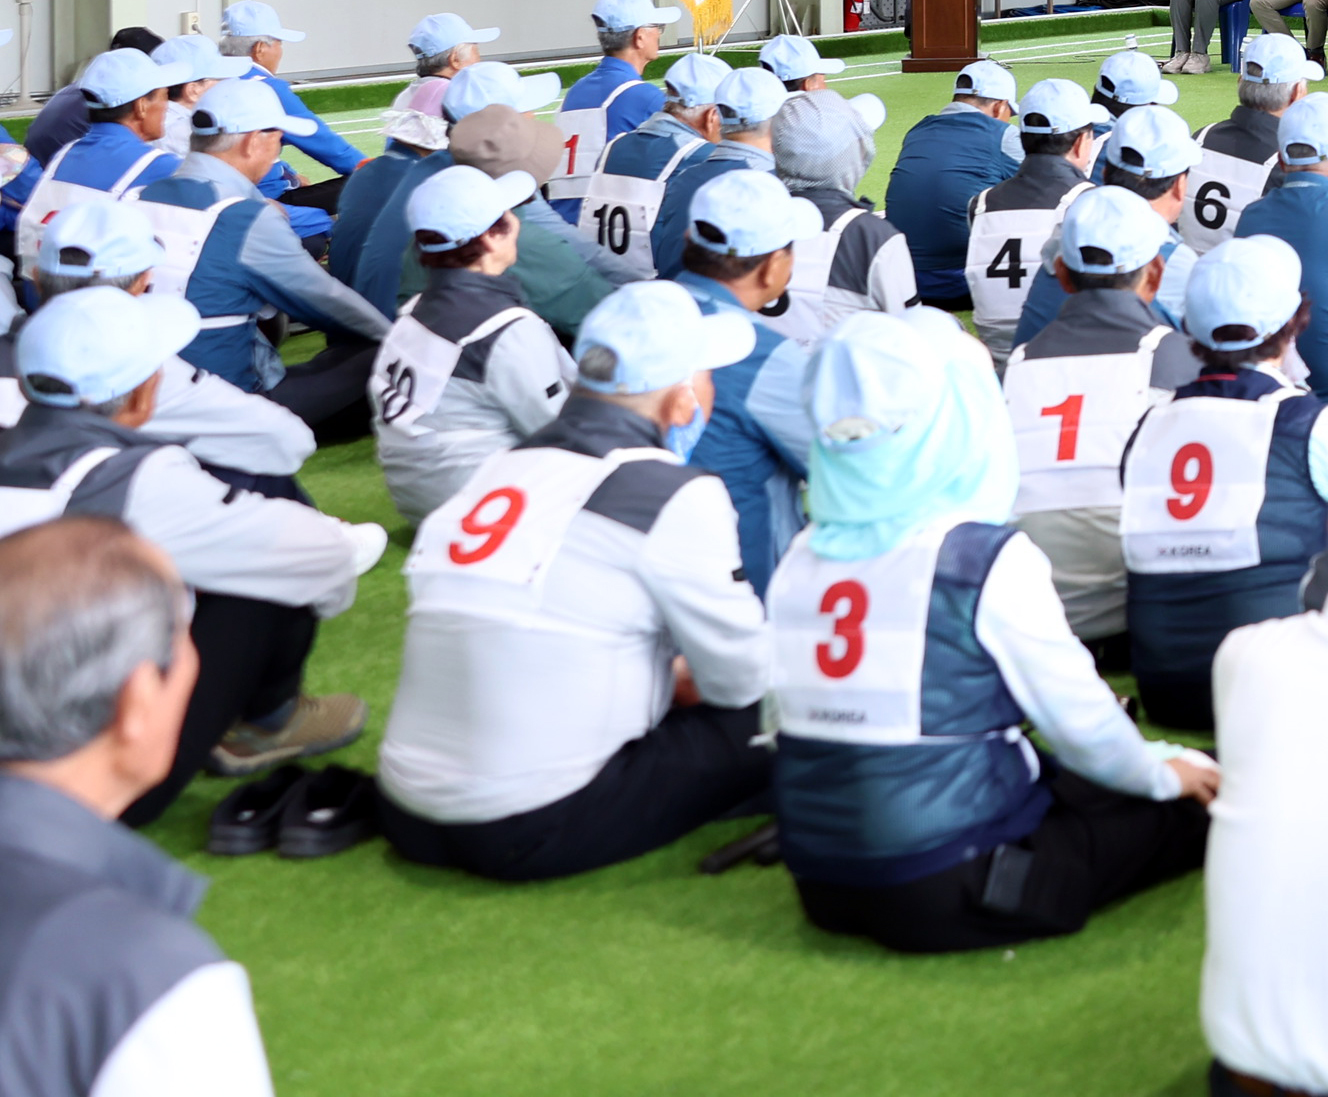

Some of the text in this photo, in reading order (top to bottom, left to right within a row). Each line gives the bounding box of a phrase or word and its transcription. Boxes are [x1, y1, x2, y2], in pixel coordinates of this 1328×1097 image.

[594, 203, 631, 256] 10
[1193, 181, 1231, 230] 6
[986, 238, 1027, 289] 4
[1040, 394, 1085, 462] 1
[1167, 442, 1214, 521] 9
[448, 486, 527, 566] 9
[815, 579, 869, 680] 3
